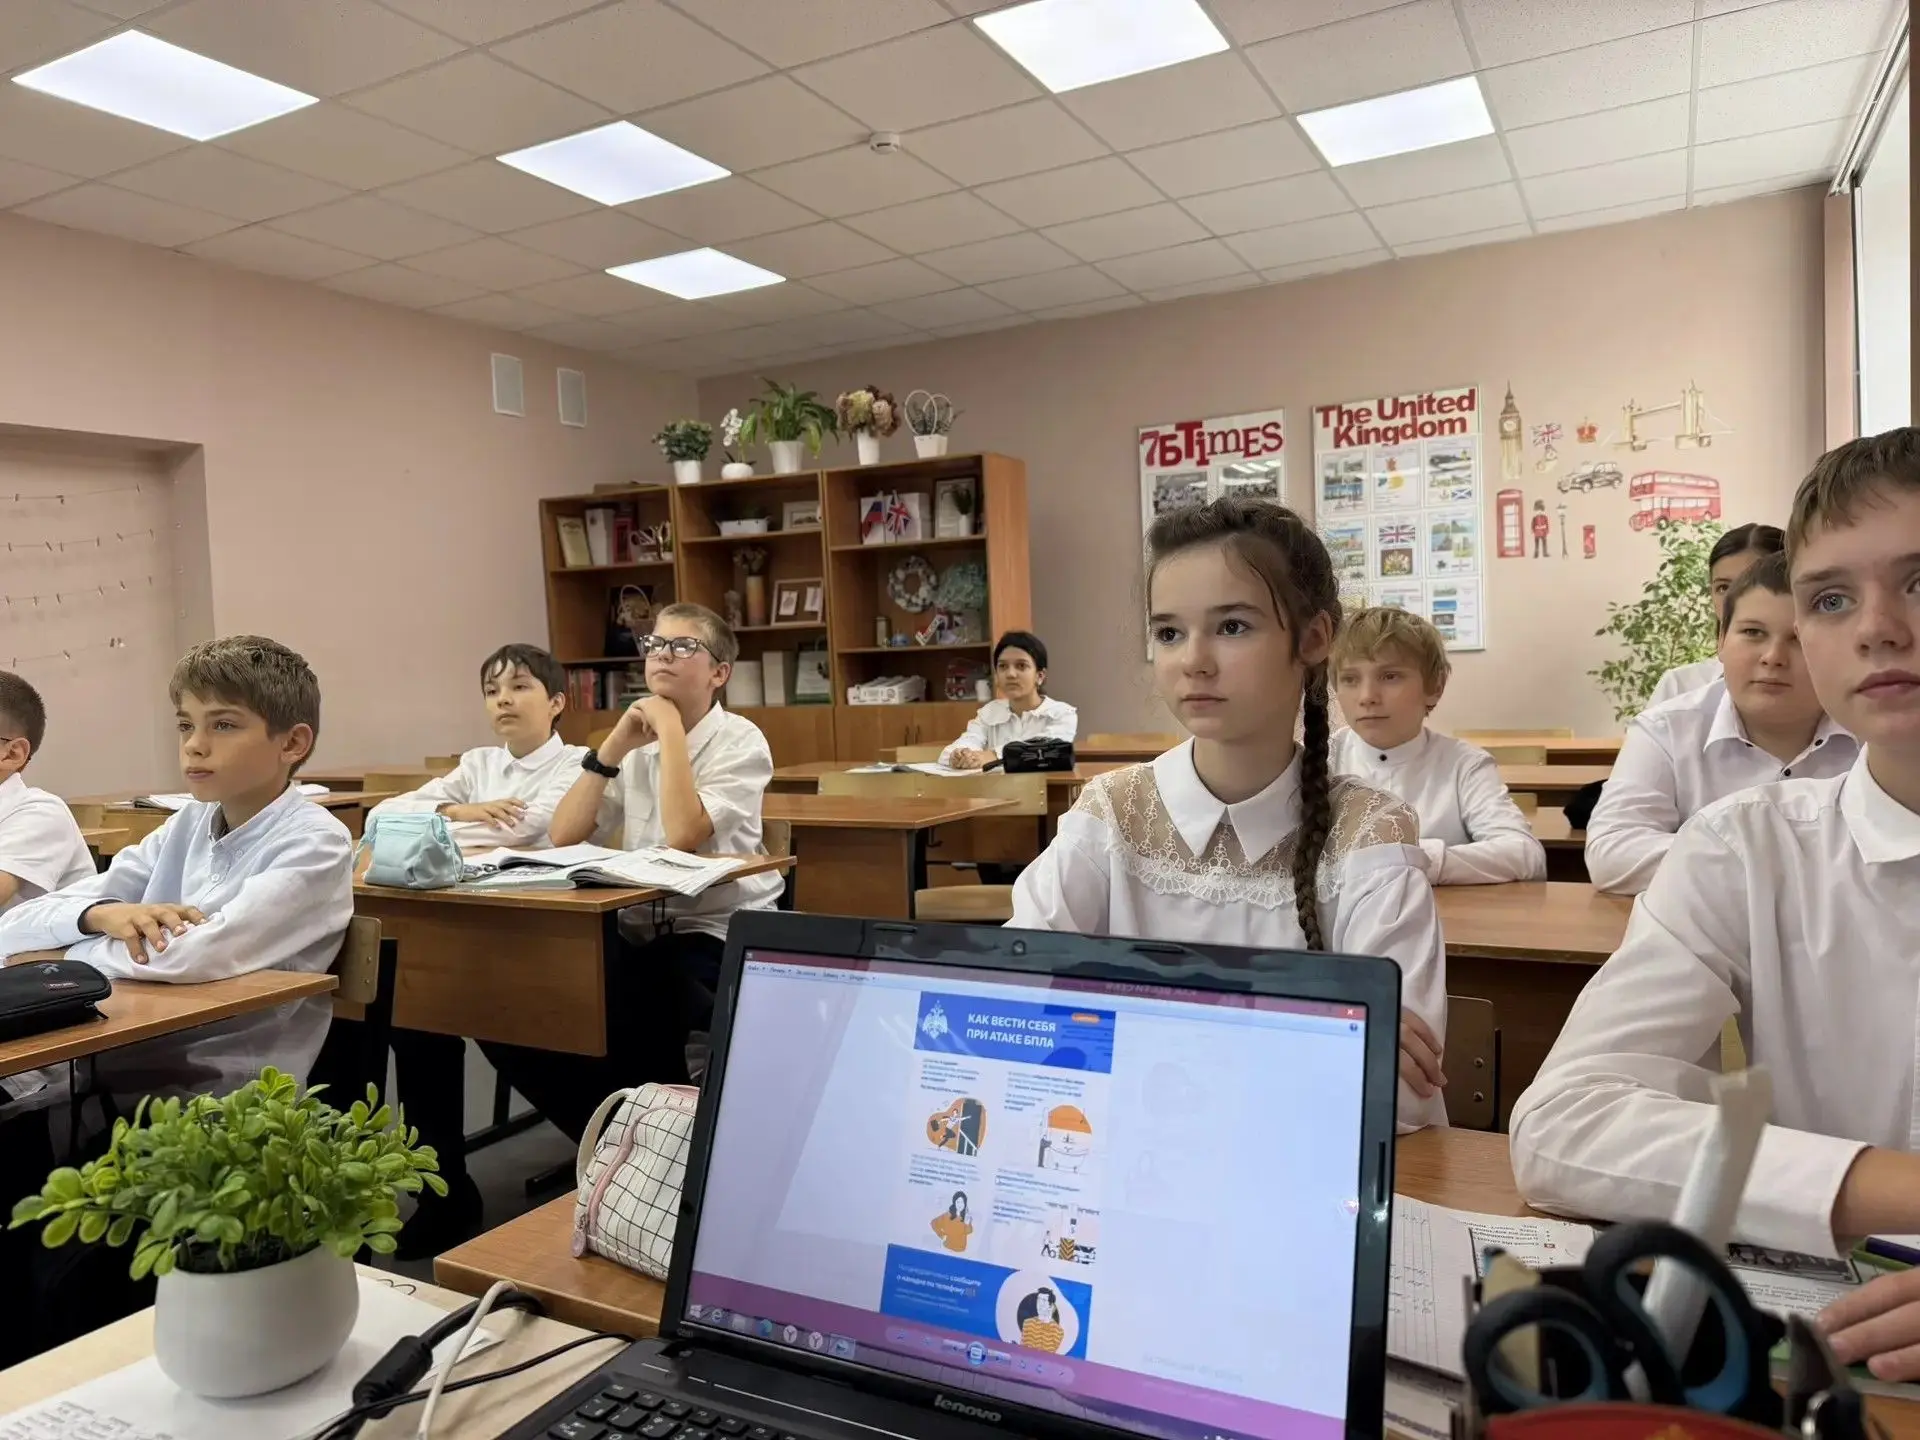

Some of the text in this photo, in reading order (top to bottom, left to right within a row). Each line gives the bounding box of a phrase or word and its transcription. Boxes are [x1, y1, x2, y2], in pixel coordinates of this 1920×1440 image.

[1316, 388, 1476, 428] The United
[1333, 416, 1467, 449] Kingdom
[967, 1013, 1057, 1033] КАК ВЕСТИ СЕБЯ
[966, 1028, 1054, 1049] ПРИ АТАКЕ БПЛА
